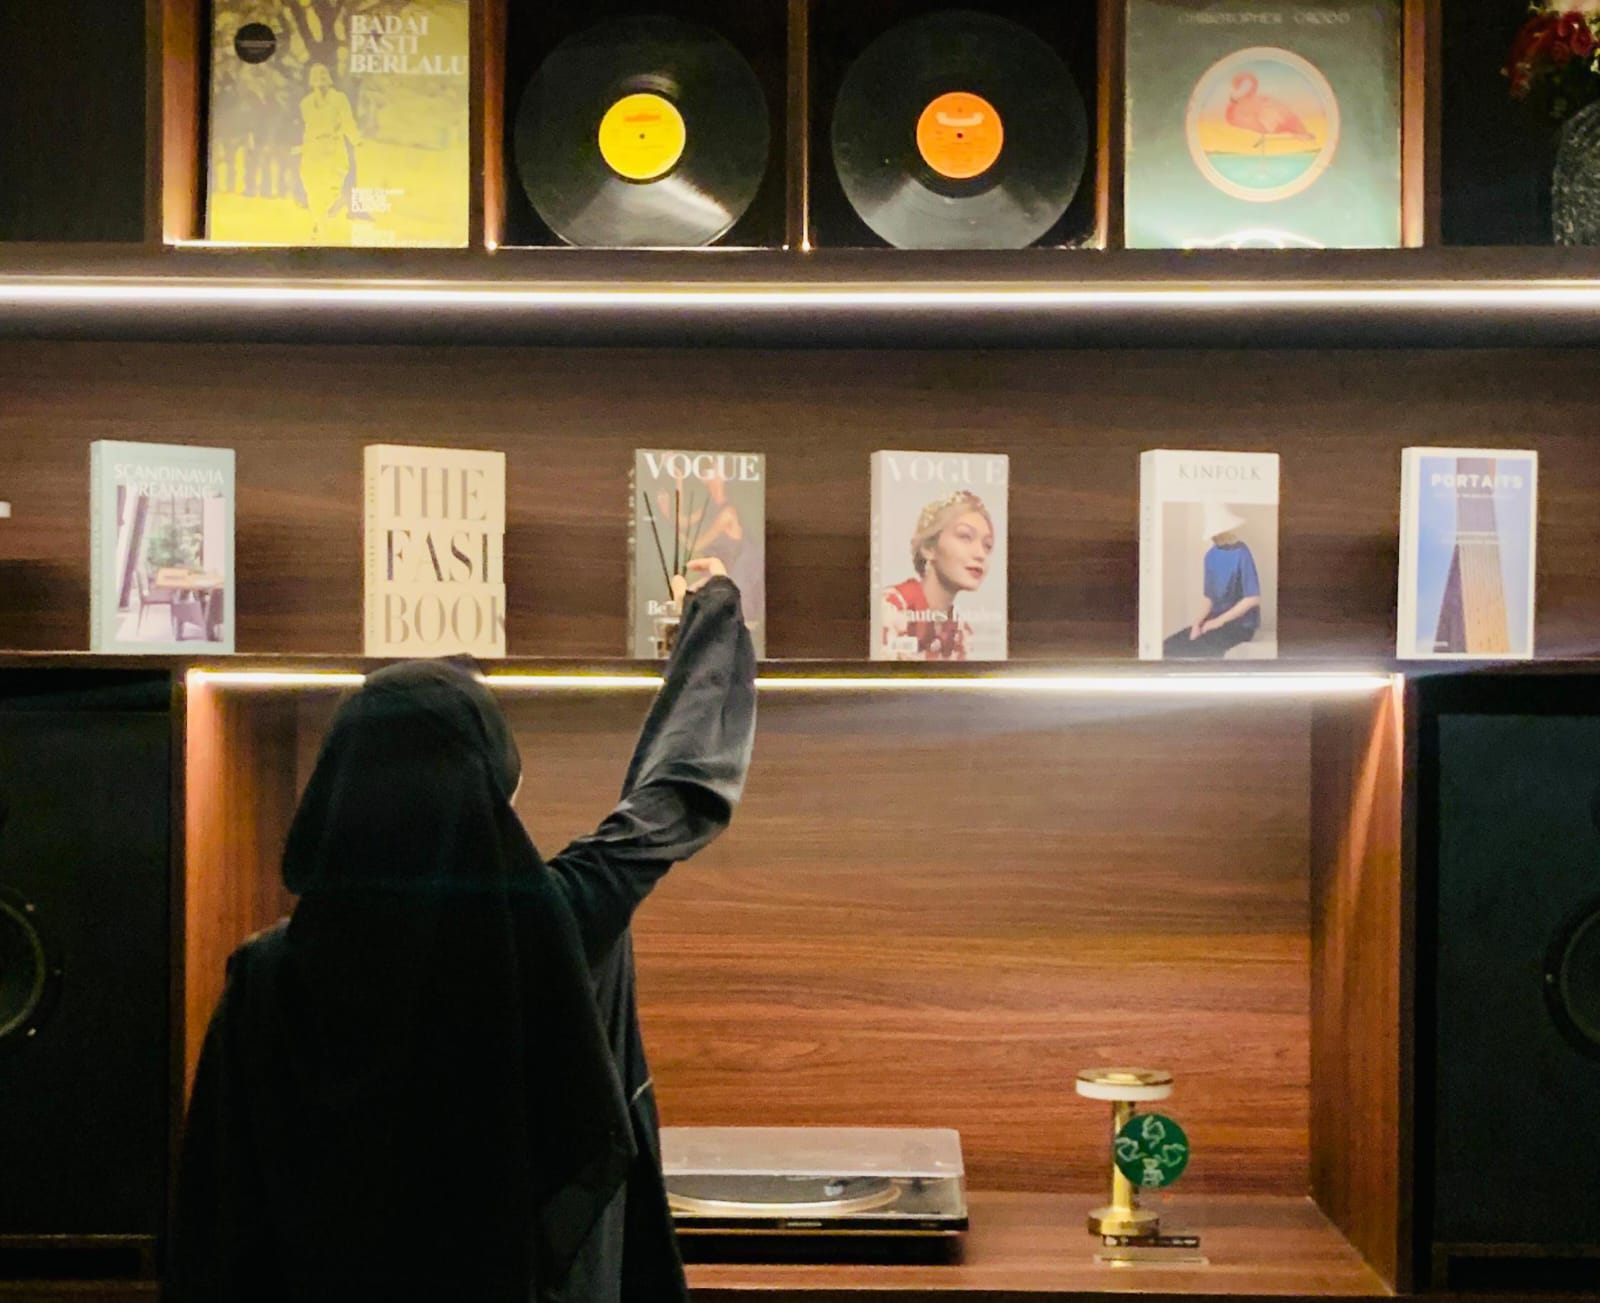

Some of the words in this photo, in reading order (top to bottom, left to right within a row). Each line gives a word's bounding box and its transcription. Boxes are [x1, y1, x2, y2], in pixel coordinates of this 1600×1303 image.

[350, 14, 429, 35] BADAI
[350, 34, 420, 55] PASTI
[349, 54, 467, 75] BERLALU
[113, 462, 225, 486] SCANDINAVIA
[643, 453, 761, 481] VOGUE
[886, 455, 1006, 485] VOGUE
[1178, 463, 1262, 481] KINFOLK
[380, 464, 488, 521] THE
